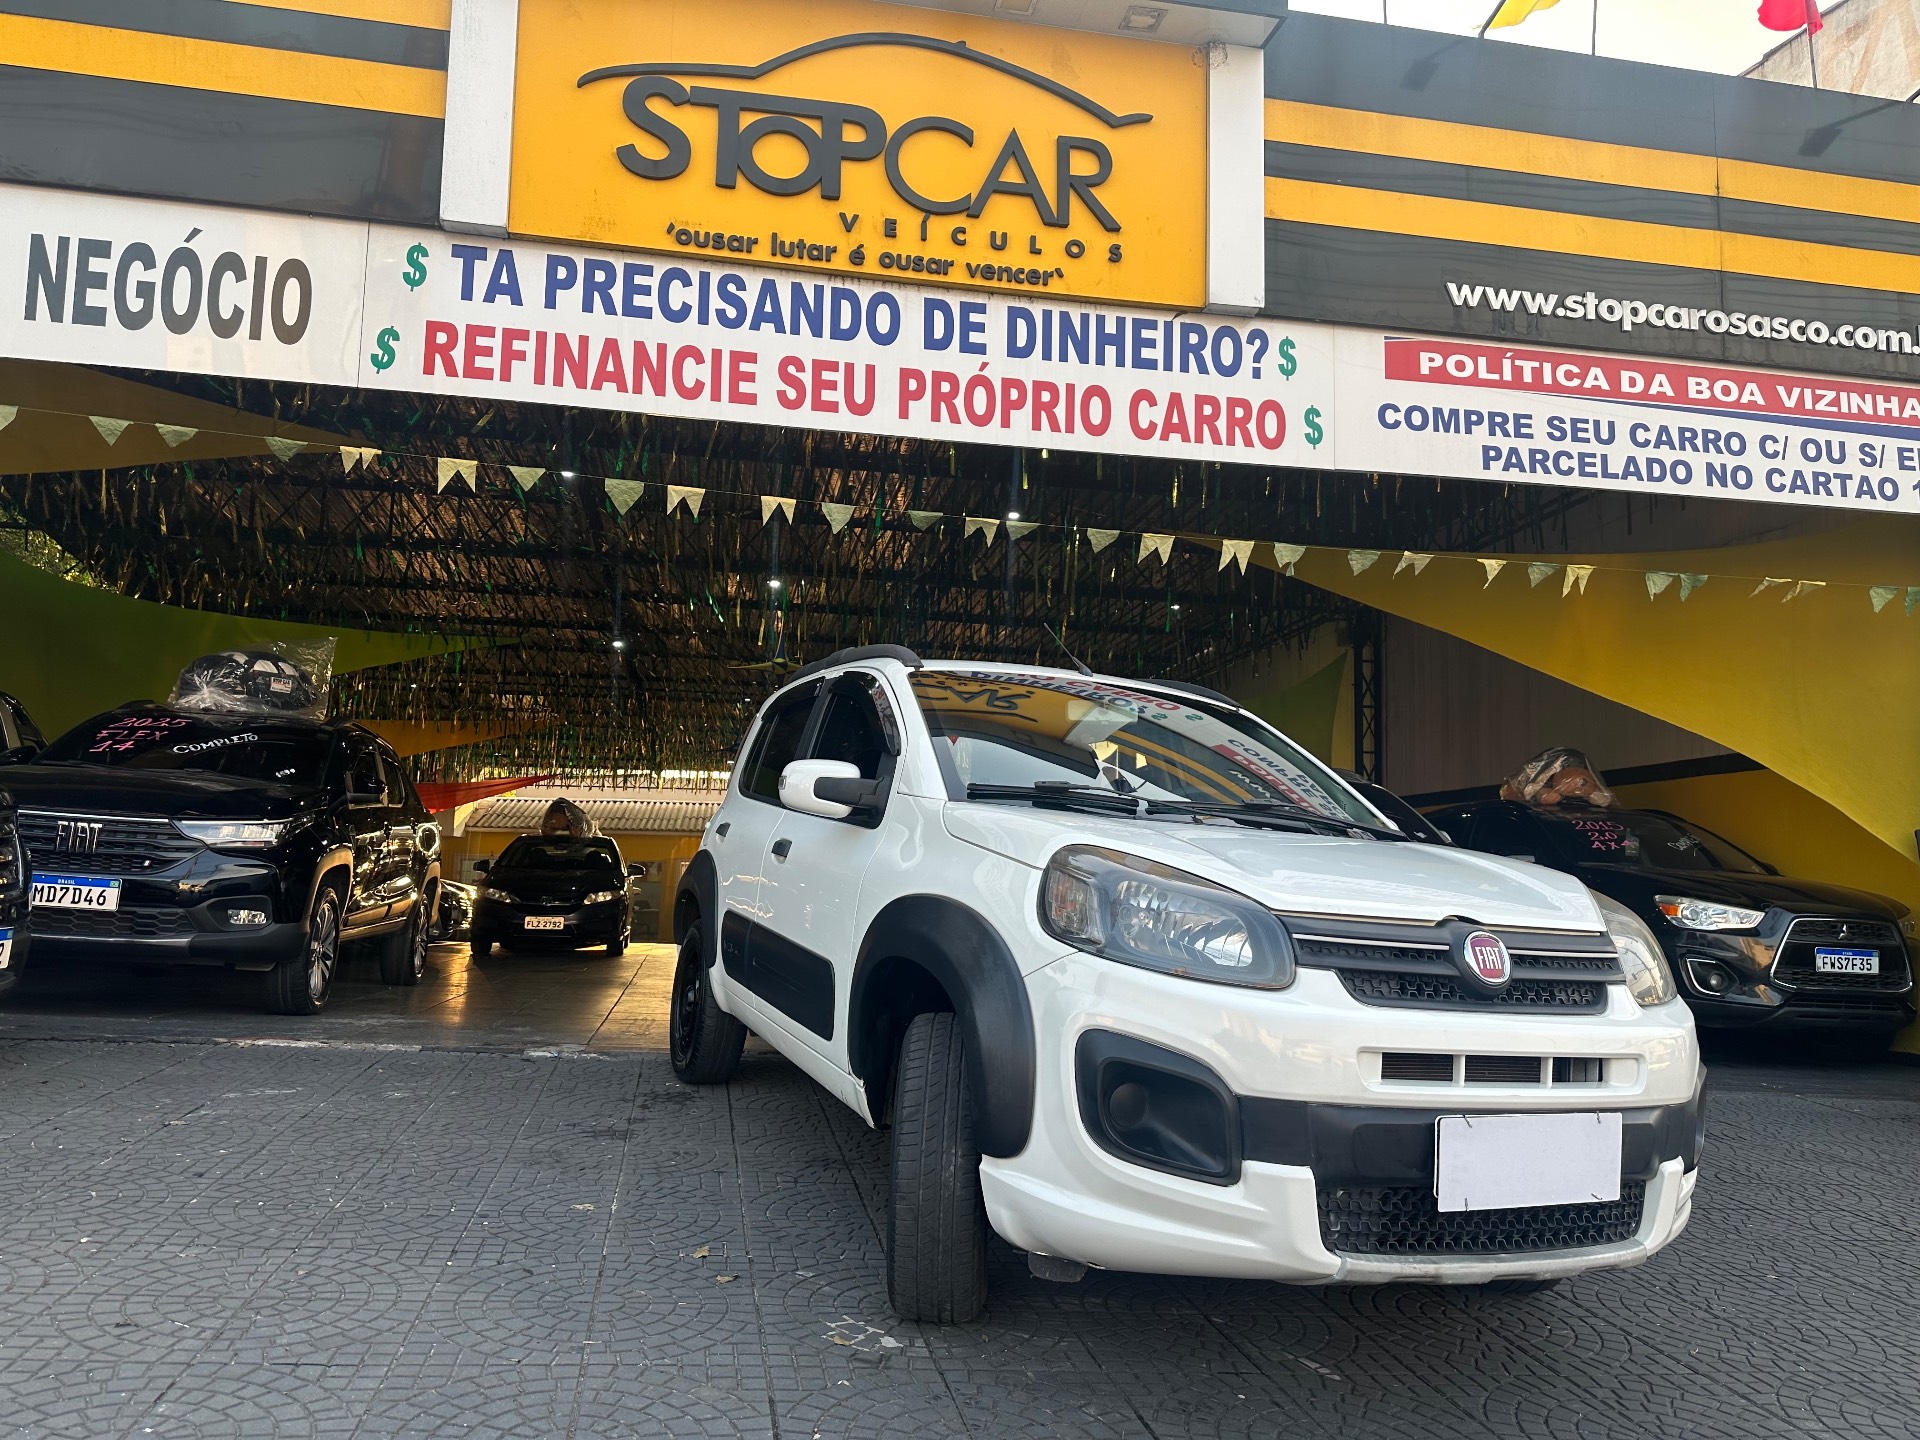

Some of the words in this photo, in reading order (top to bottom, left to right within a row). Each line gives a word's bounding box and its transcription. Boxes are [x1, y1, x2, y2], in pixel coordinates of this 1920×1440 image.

[616, 76, 1122, 231] STOPCAR
[770, 231, 838, 262] lutar
[849, 243, 866, 266] é
[878, 250, 955, 275] ousar
[839, 212, 1123, 262] VEÍCULOS
[23, 227, 313, 346] NEGÓCIO
[450, 243, 524, 307] TA
[543, 253, 901, 347] PRECISANDO
[923, 297, 988, 355] DE
[1006, 304, 1270, 380] DINHEIRO?
[1445, 281, 1920, 355] www.stopcarosasco.com.
[422, 320, 758, 406] REFINANCIE
[776, 355, 876, 417] SEU
[899, 362, 1112, 437] PRÓPRIO
[1128, 388, 1287, 451] CARRO
[1418, 351, 1604, 391] POLÍTICA
[1619, 369, 1676, 397] DA
[1687, 377, 1767, 406] BOA
[1377, 402, 1534, 440] COMPRE
[1546, 415, 1616, 446] SEU
[1629, 422, 1748, 457] CARRO
[1759, 434, 1789, 461] C/
[1800, 437, 1847, 465] OU
[1858, 442, 1886, 469] S/
[1896, 446, 1920, 472] E
[1481, 444, 1694, 486] PARCELADO
[1705, 462, 1754, 490] NO
[1764, 467, 1900, 502] CARTAO
[95, 729, 169, 741] FLEX
[109, 717, 192, 728] 2025
[172, 732, 259, 754] COMPLETO
[55, 820, 104, 854] FIAT
[1571, 819, 1625, 831] 2015
[1474, 946, 1502, 970] FIAT
[1822, 956, 1873, 972] FWS7F35
